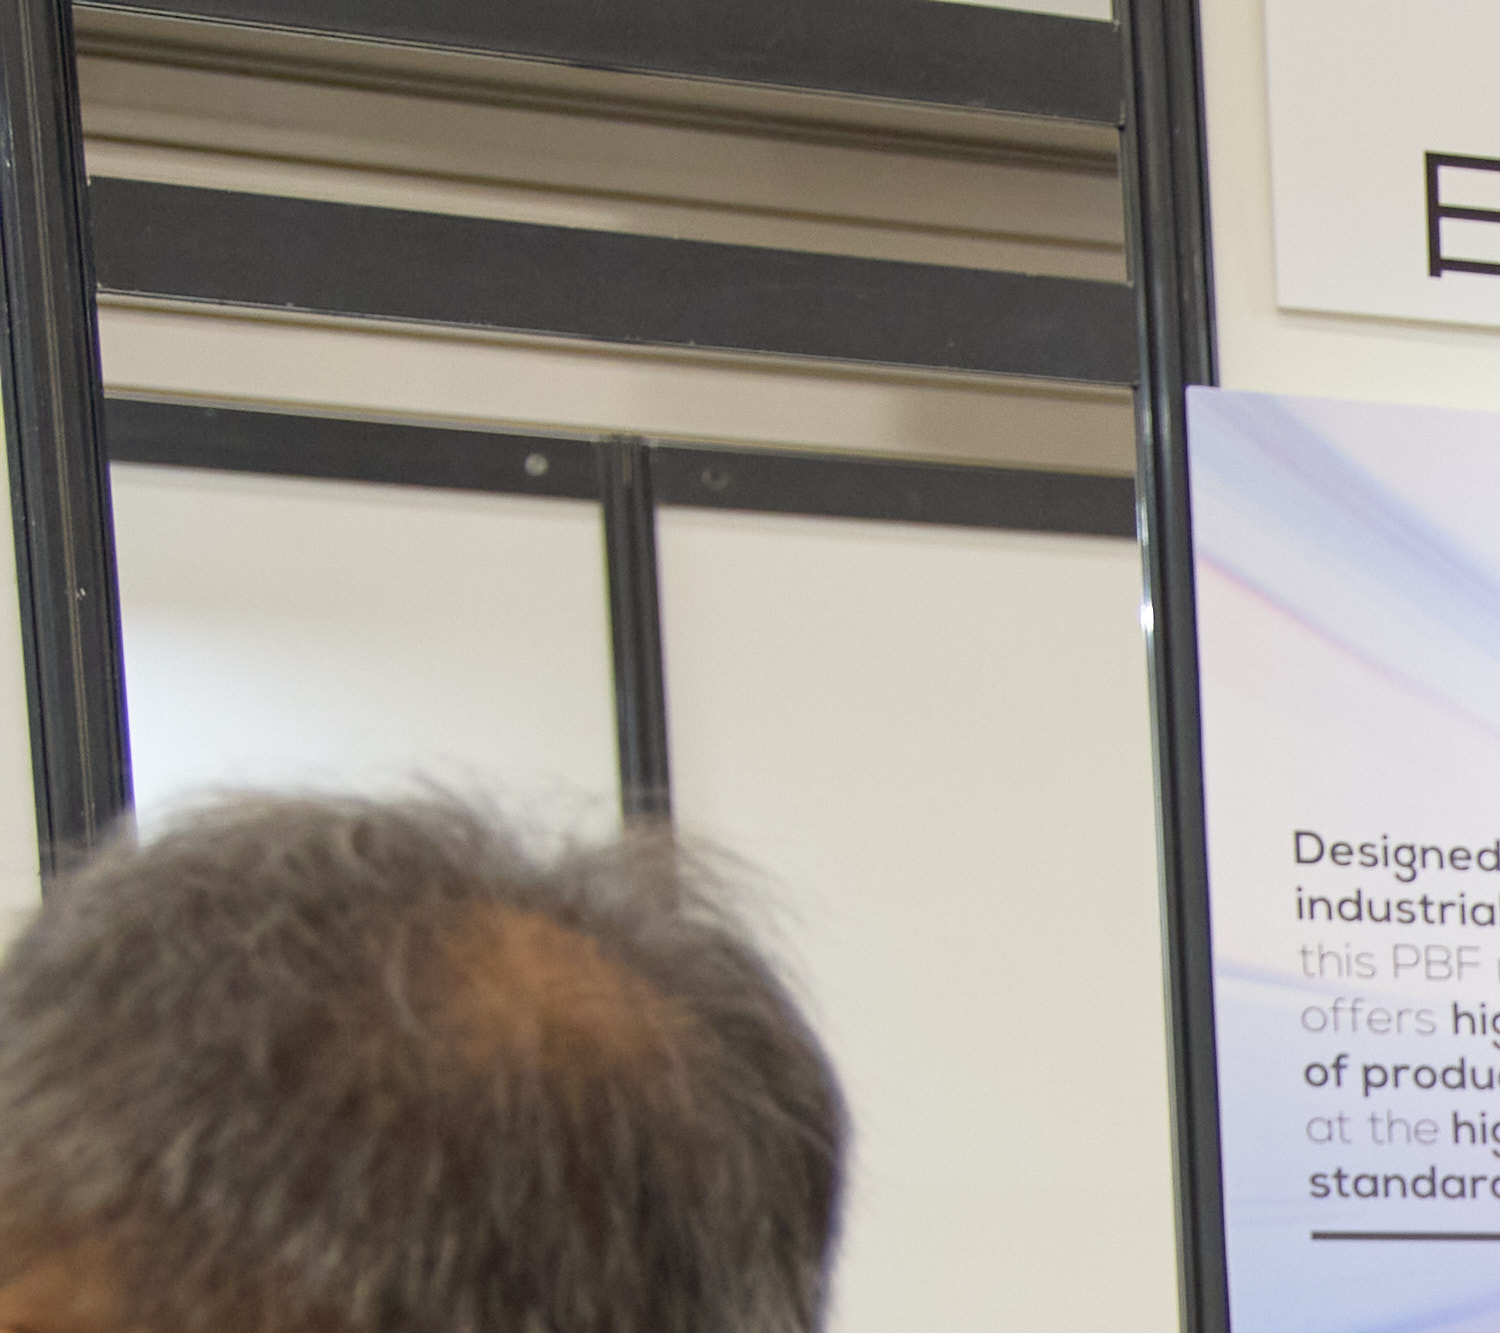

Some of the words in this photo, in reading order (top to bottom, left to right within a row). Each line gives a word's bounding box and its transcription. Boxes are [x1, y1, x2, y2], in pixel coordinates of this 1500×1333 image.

[1299, 942, 1377, 980] this
[1391, 943, 1482, 982] PBF
[1300, 997, 1438, 1037] offers
[1303, 1052, 1349, 1089] of
[1305, 1111, 1352, 1146] at
[1369, 1109, 1441, 1146] the
